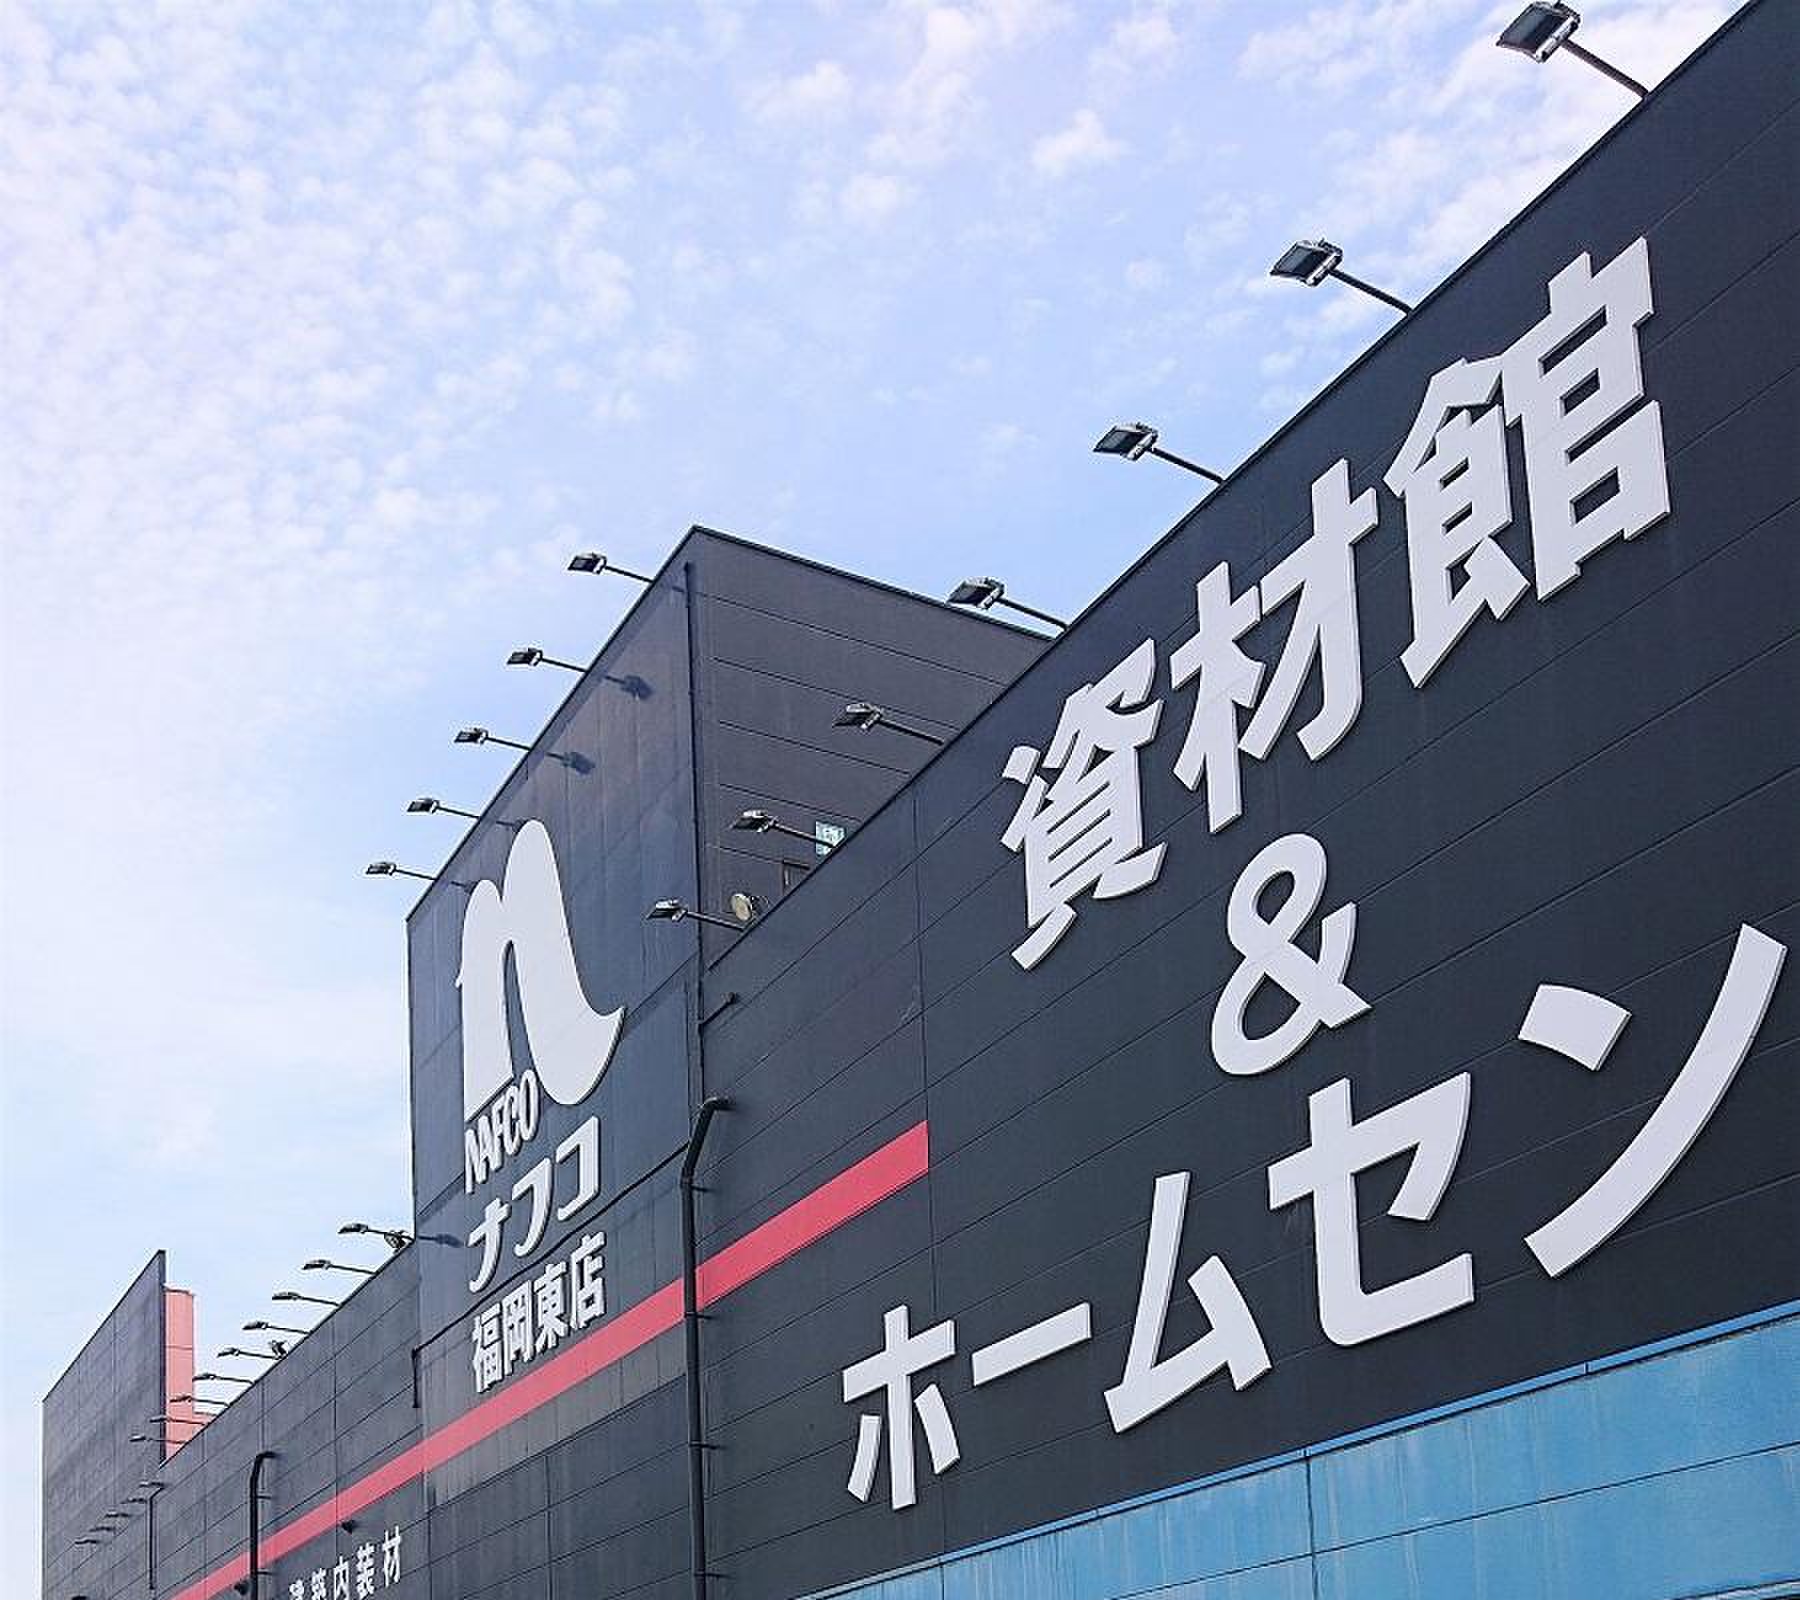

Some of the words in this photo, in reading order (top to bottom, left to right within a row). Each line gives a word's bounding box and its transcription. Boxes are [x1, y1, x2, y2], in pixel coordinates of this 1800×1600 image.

[1001, 237, 1670, 969] 資材館
[1210, 833, 1372, 1077] &
[465, 1070, 538, 1194] NAFCO
[469, 1116, 598, 1292] ナフコ
[843, 924, 1786, 1508] ホームセン
[472, 1232, 604, 1392] 福岡東店
